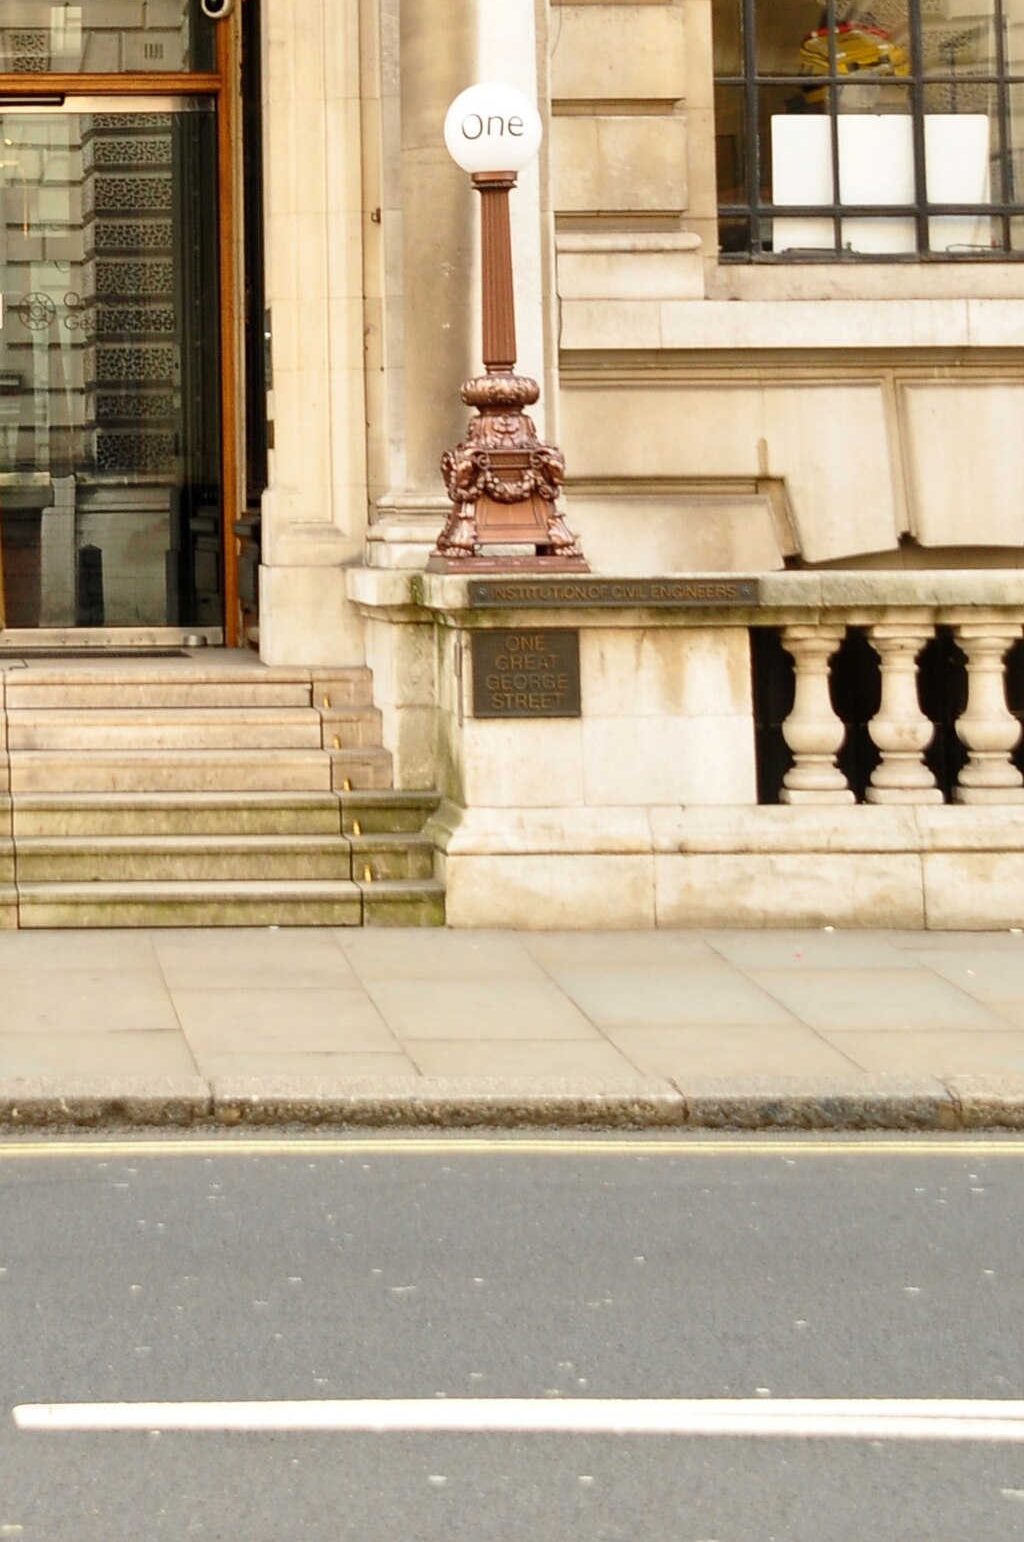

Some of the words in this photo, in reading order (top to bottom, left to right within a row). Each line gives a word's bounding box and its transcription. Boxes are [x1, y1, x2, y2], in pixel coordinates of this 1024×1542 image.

[491, 585, 587, 599] INSTITUTION
[588, 585, 609, 599] OF
[611, 585, 647, 599] CIVIL
[651, 584, 737, 599] ENGINEERS
[506, 635, 545, 651] ONE
[496, 654, 558, 671] GREAT
[486, 673, 569, 690] GEORGE
[491, 692, 563, 709] STREET
